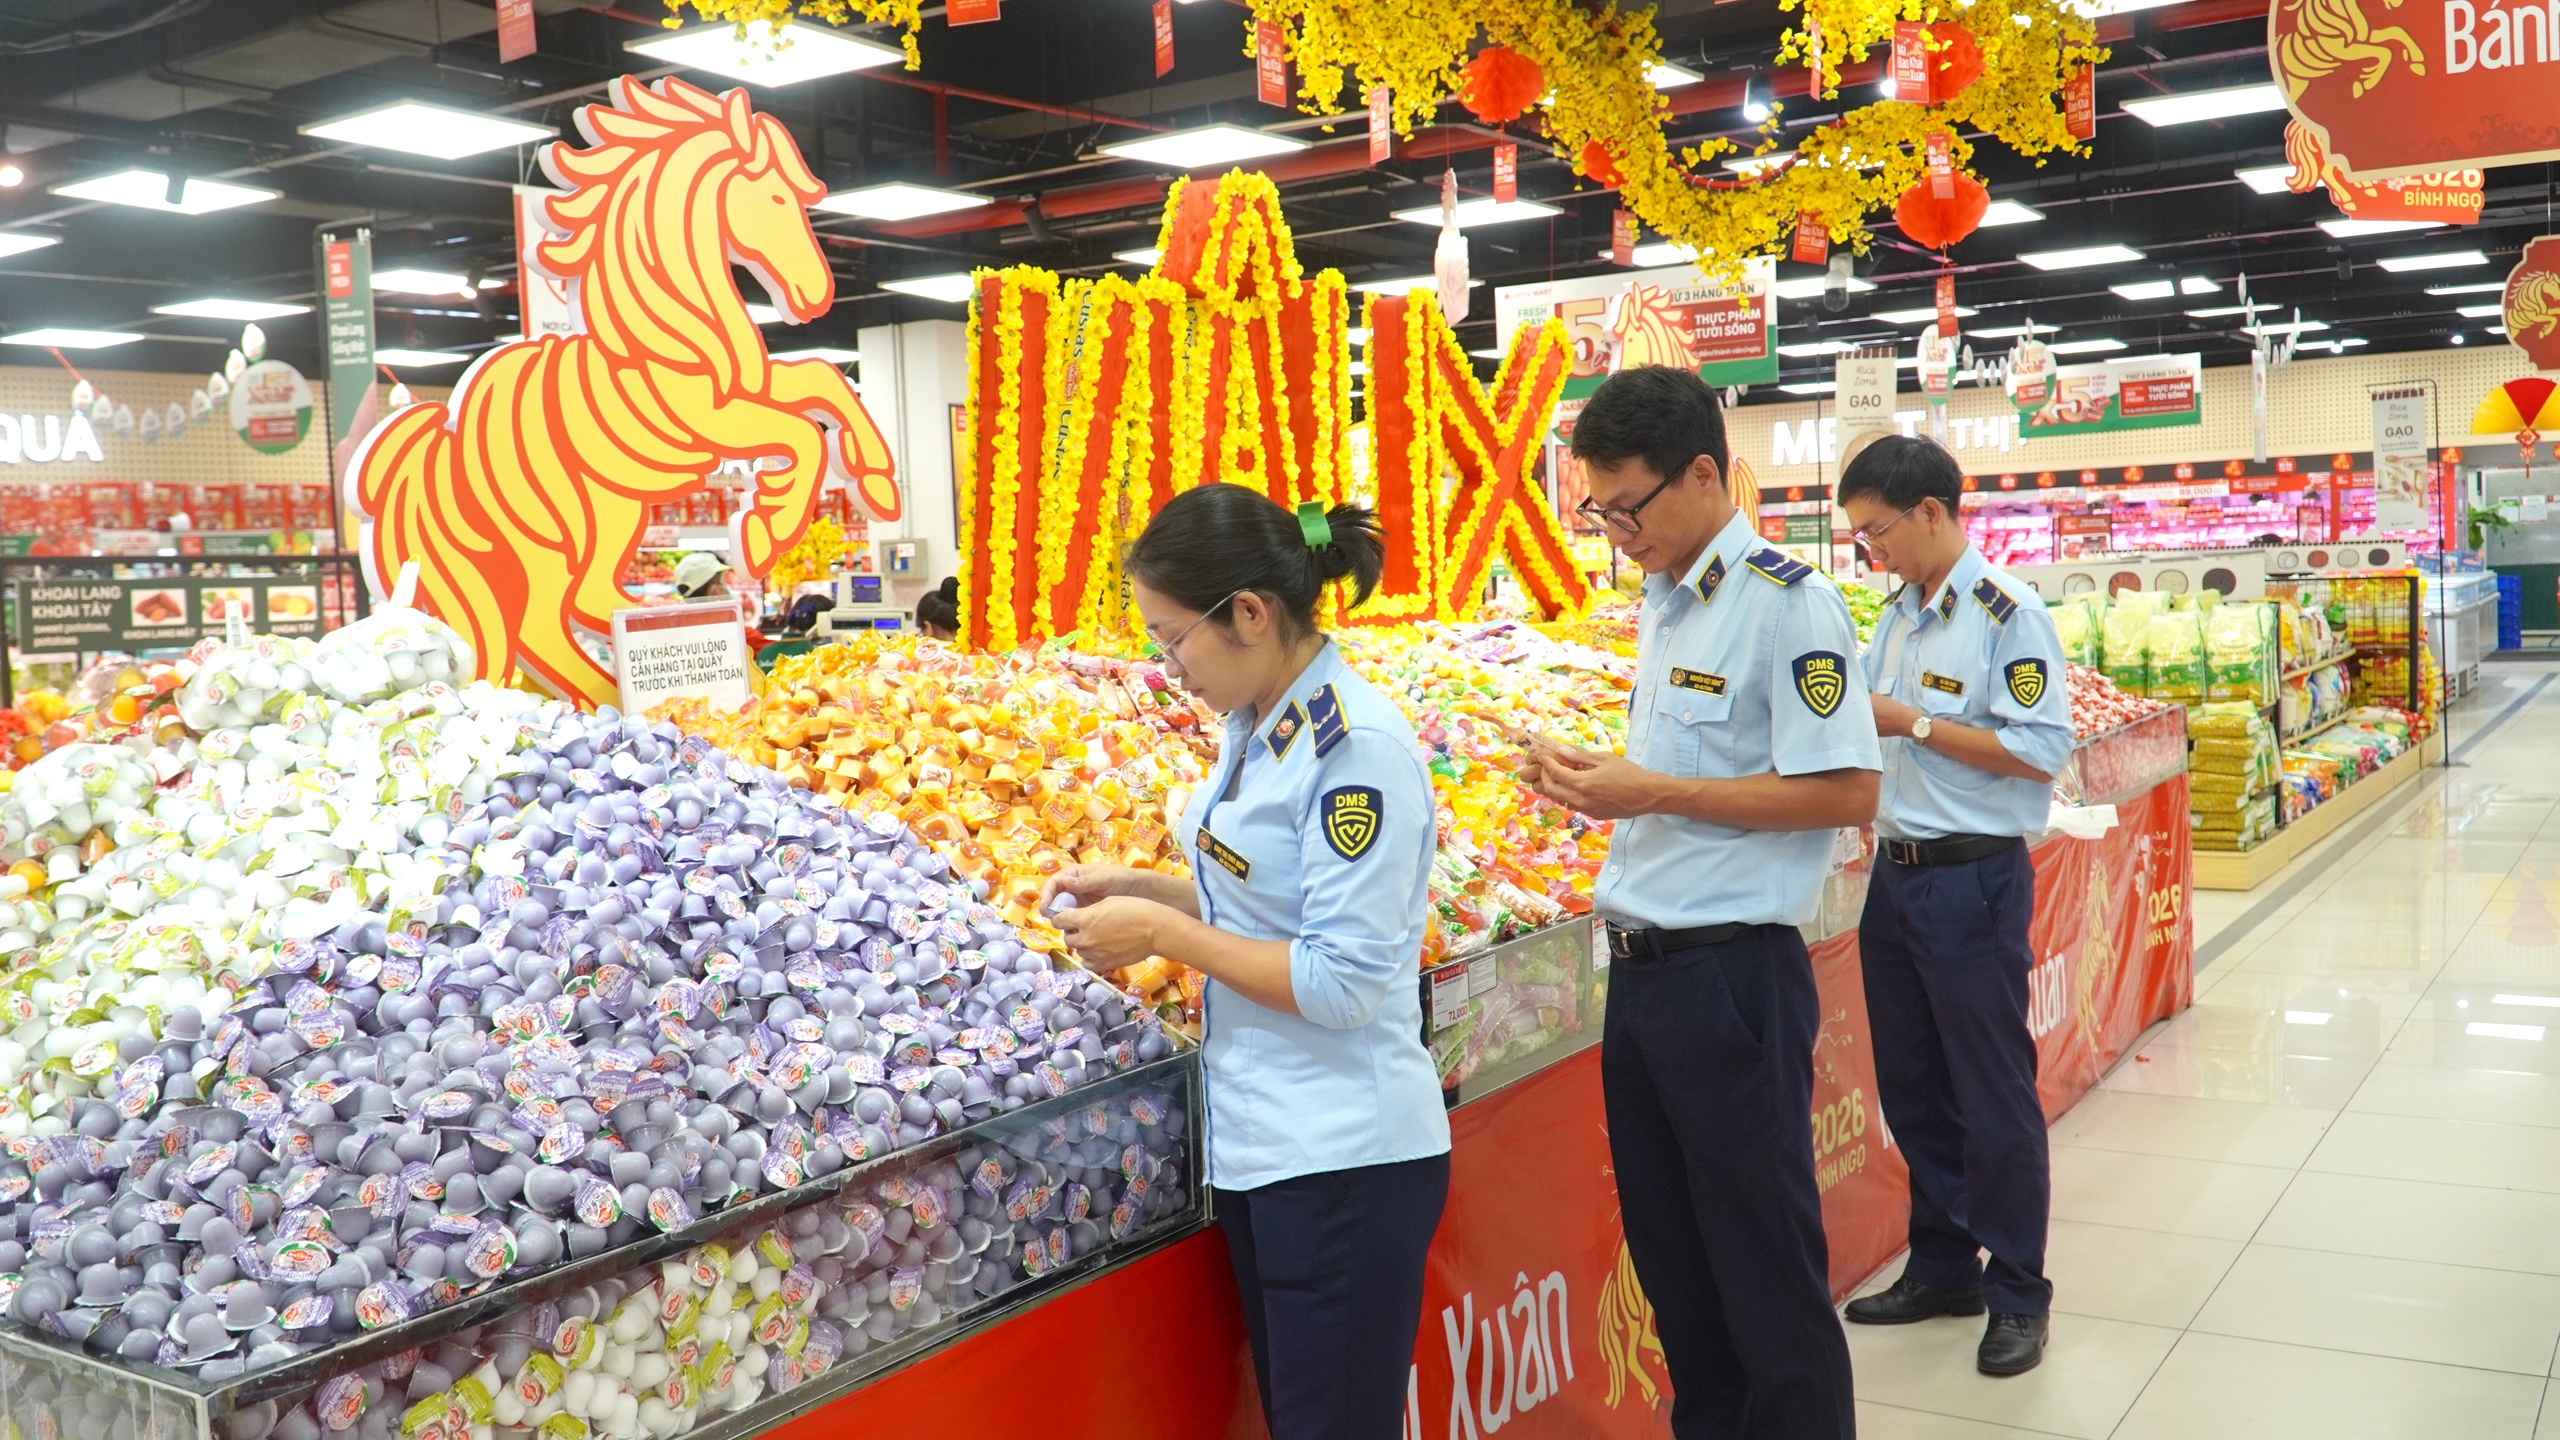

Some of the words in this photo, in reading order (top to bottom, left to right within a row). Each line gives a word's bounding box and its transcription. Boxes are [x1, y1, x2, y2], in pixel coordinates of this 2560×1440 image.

[2404, 189, 2443, 207] BÍNH
[2447, 192, 2482, 212] NGỌ
[1518, 305, 1547, 318] FRESH
[1694, 311, 1726, 329] THỰC
[1856, 364, 1877, 375] Rice
[1854, 376, 1878, 387] Zone
[1849, 394, 1882, 411] GẠO
[1772, 411, 1927, 467] MET
[2385, 425, 2414, 440] GẠO
[1120, 541, 1133, 612] Cstas
[31, 587, 78, 601] KHOAI
[80, 585, 121, 600] LANG
[31, 605, 79, 620] KHOAI
[82, 602, 112, 618] TÂY
[202, 626, 227, 637] KHOA
[629, 644, 648, 663] QUÝ
[650, 642, 683, 661] KHÁCH
[685, 643, 701, 656] VUI
[703, 638, 728, 654] LÒNG
[630, 662, 651, 678] CÂN
[653, 658, 679, 675] HÀNG
[682, 657, 696, 674] TẠI
[1807, 658, 1834, 671] DMS
[2014, 662, 2036, 675] DMS
[632, 672, 666, 693] TRƯỚC
[668, 674, 684, 689] KHI
[685, 671, 717, 686] THANH
[719, 665, 744, 682] TOÁN
[1335, 793, 1369, 808] DMS
[2148, 883, 2181, 925] 026
[1448, 1004, 1468, 1022] 71,000
[1811, 1087, 1866, 1162] 2026
[1840, 1143, 1866, 1180] NGỌ
[1441, 1270, 1575, 1440] Xuân
